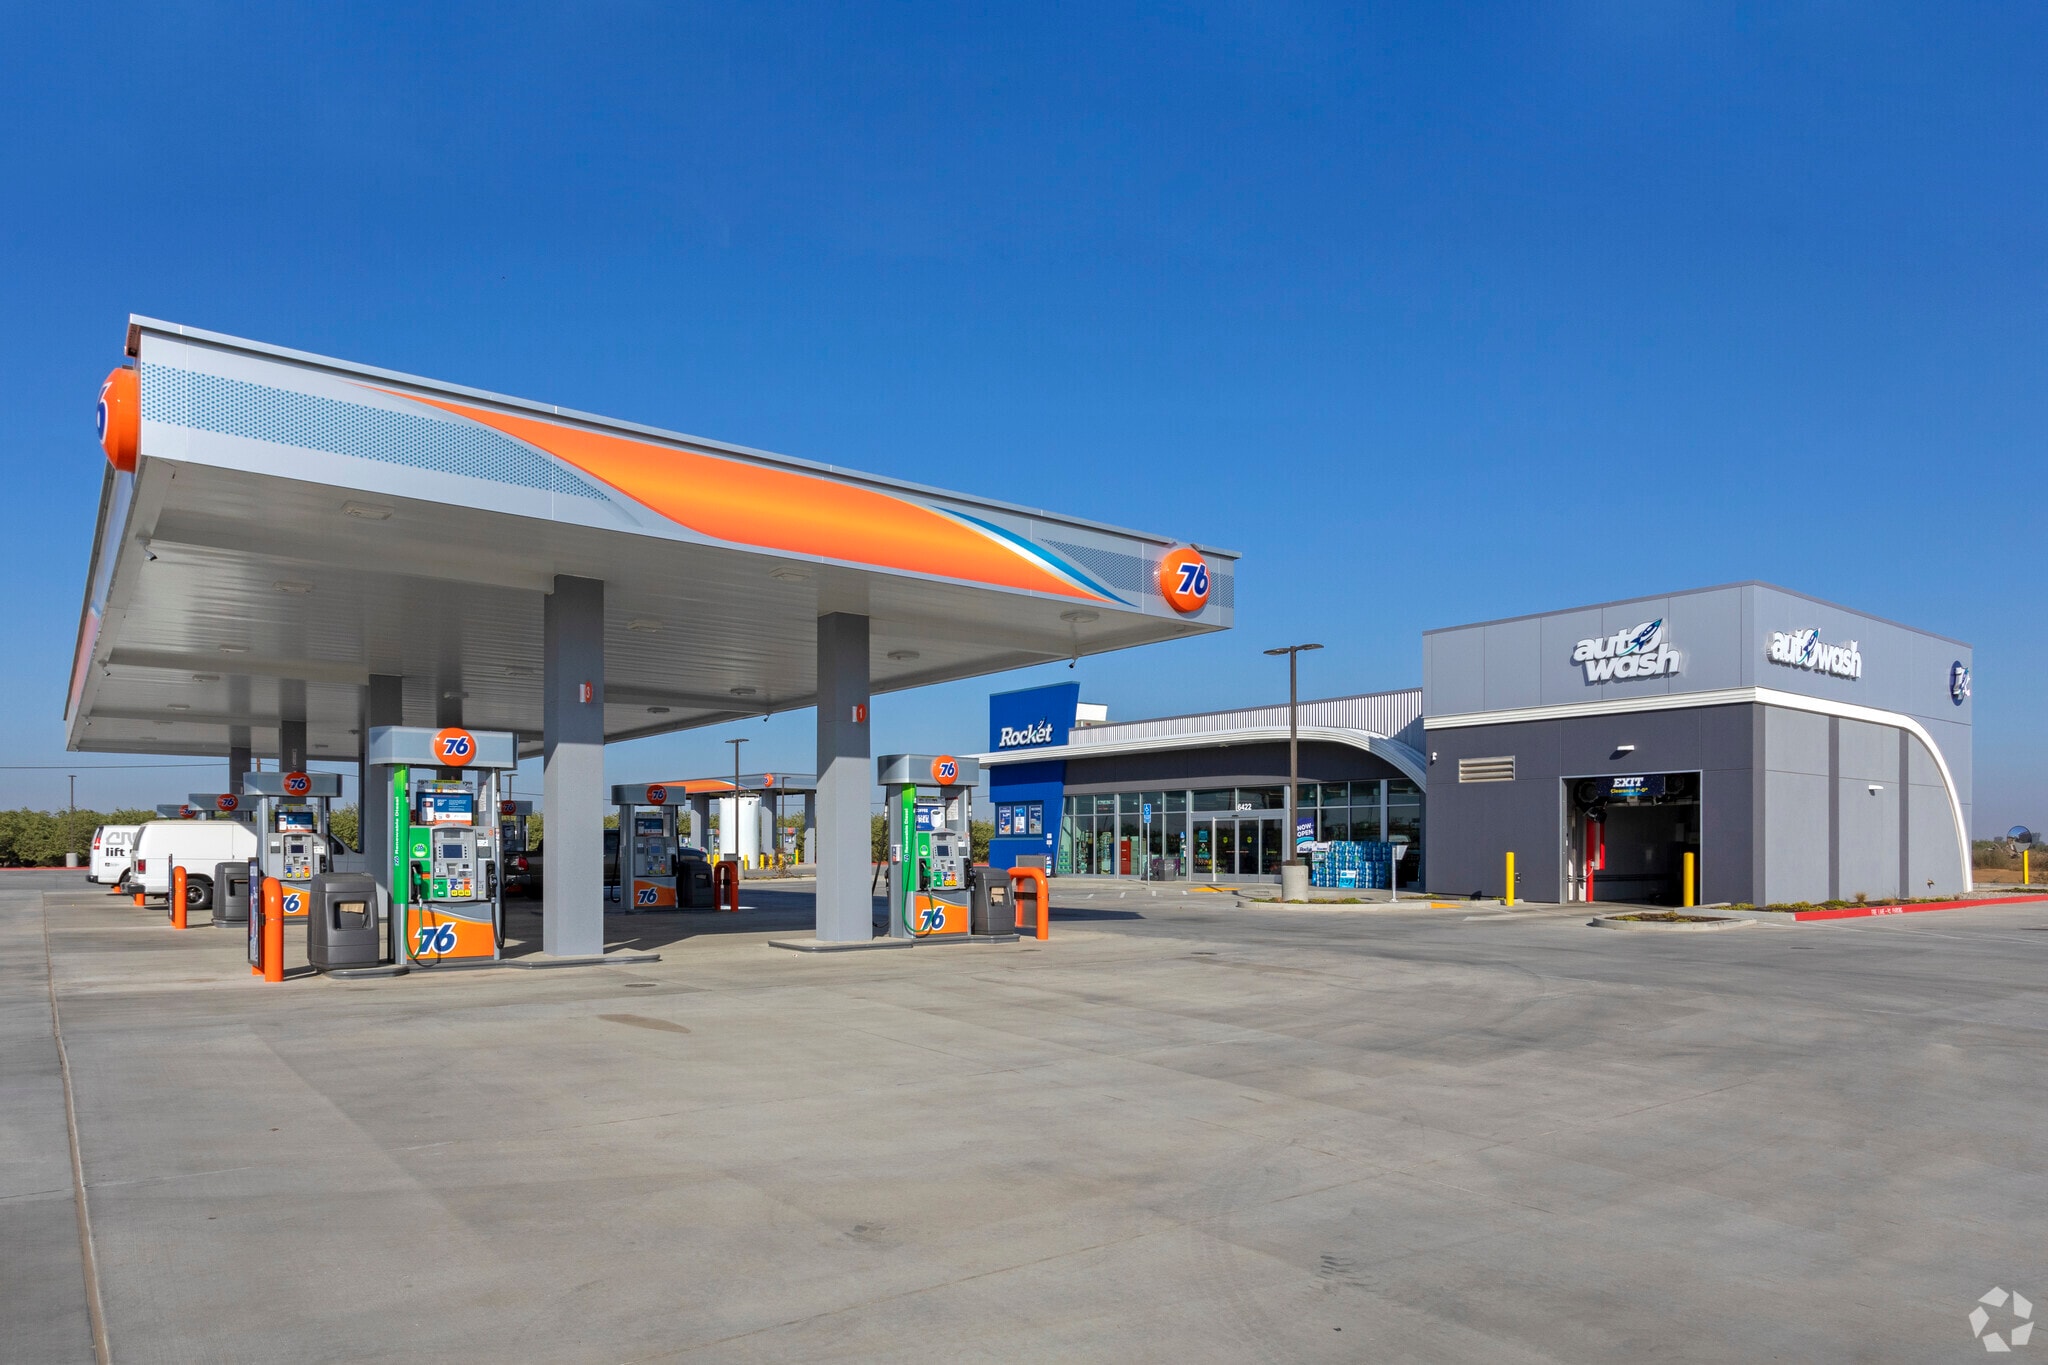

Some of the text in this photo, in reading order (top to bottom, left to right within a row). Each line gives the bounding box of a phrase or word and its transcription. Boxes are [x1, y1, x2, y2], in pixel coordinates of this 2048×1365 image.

[1175, 562, 1209, 598] 76
[1574, 620, 1662, 661] auto
[1585, 642, 1680, 682] wash
[443, 736, 470, 756] 76
[939, 762, 956, 777] 76
[289, 778, 307, 790] 76
[1612, 777, 1645, 788] EXIT
[222, 797, 235, 807] 76
[652, 789, 664, 800] 76
[1297, 823, 1312, 831] NOW
[1297, 829, 1313, 837] OPEN
[106, 847, 125, 856] lift
[637, 887, 658, 904] 76
[919, 906, 946, 931] 76
[414, 922, 458, 955] 76
